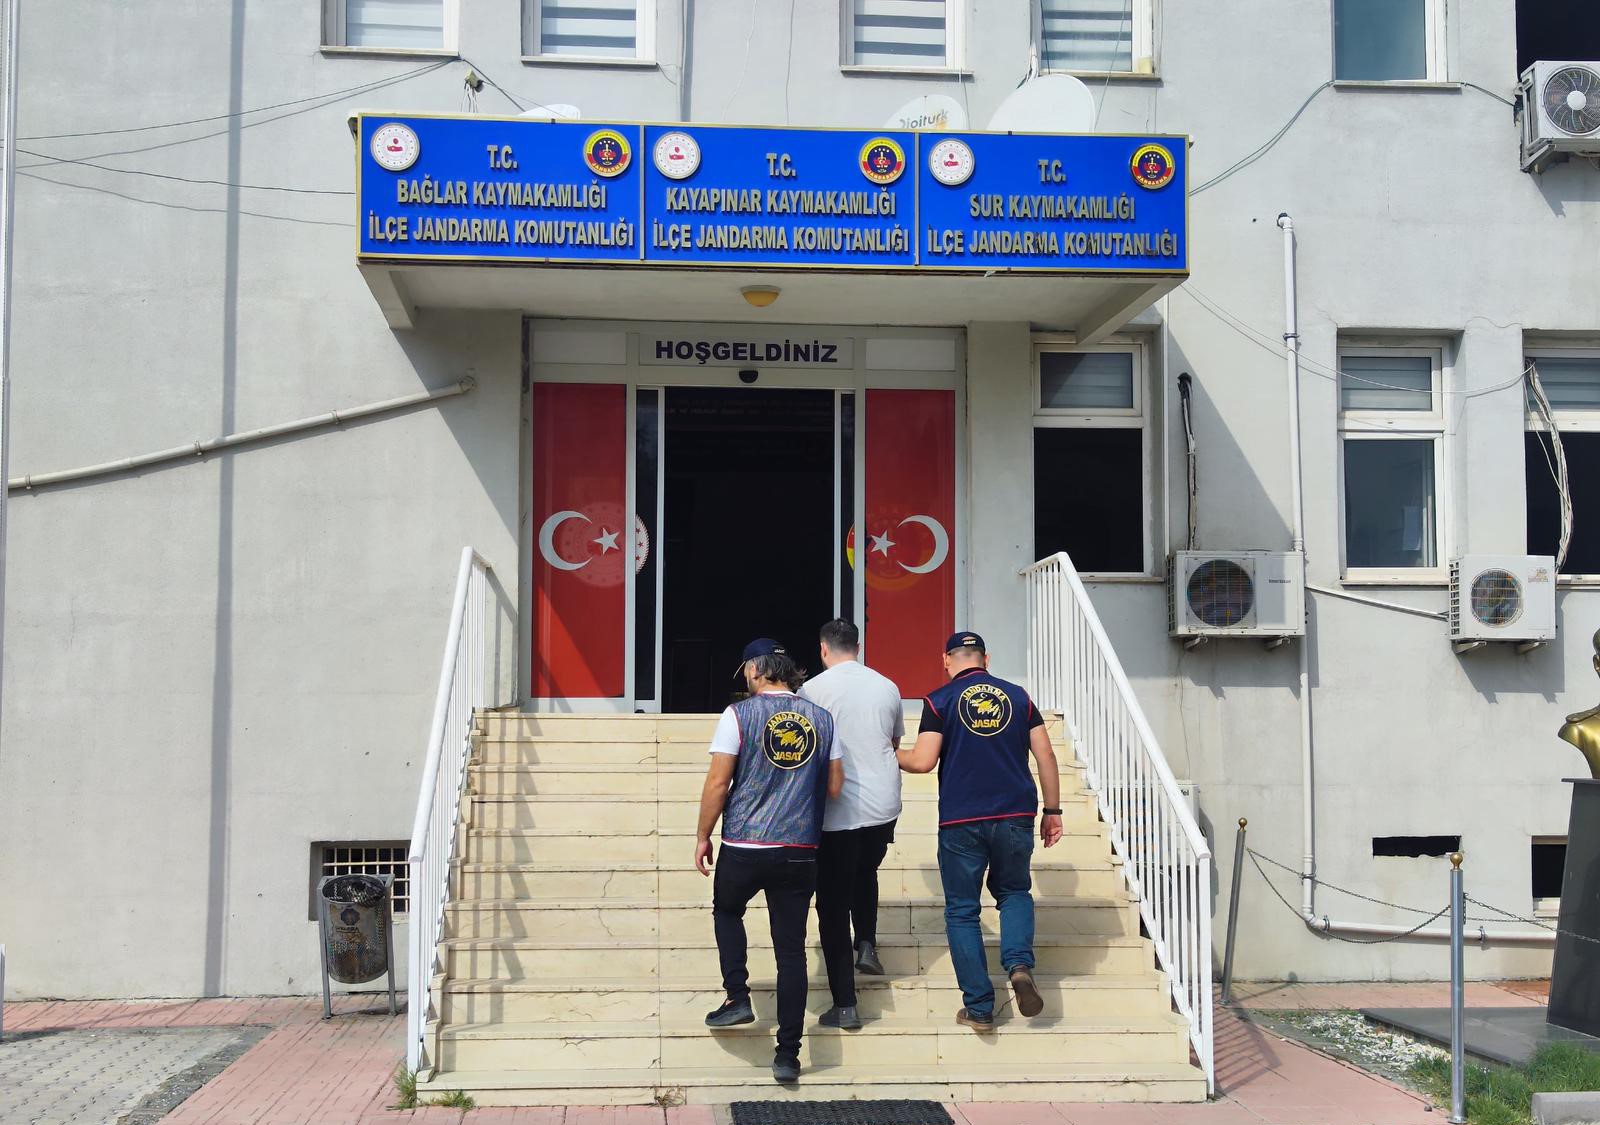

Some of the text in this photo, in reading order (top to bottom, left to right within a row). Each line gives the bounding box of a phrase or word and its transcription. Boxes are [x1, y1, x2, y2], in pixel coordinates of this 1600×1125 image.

[487, 145, 518, 169] T.C.
[766, 153, 797, 177] T.C.
[1038, 159, 1067, 183] T.C.
[397, 174, 606, 208] BAĞLAR KAYMAKAMLIĞI
[666, 186, 896, 215] KAYAPINAR KAYMAKAMLIĞI
[970, 192, 1135, 220] SUR KAYMAKAMLIĞI
[369, 210, 634, 246] İLÇE JANDARMA KOMUTANLIĞI
[653, 218, 909, 252] İLÇE JANDARMA KOMUTANLIĞI
[928, 224, 1177, 256] İLÇE JANDARMA KOMUTANLIĞI
[655, 339, 838, 364] HOŞGELDİNİZ
[962, 685, 1007, 702] JANDARMA
[767, 713, 812, 732] JANDARMA
[972, 719, 1000, 728] JASAT
[773, 751, 802, 761] JASAT
